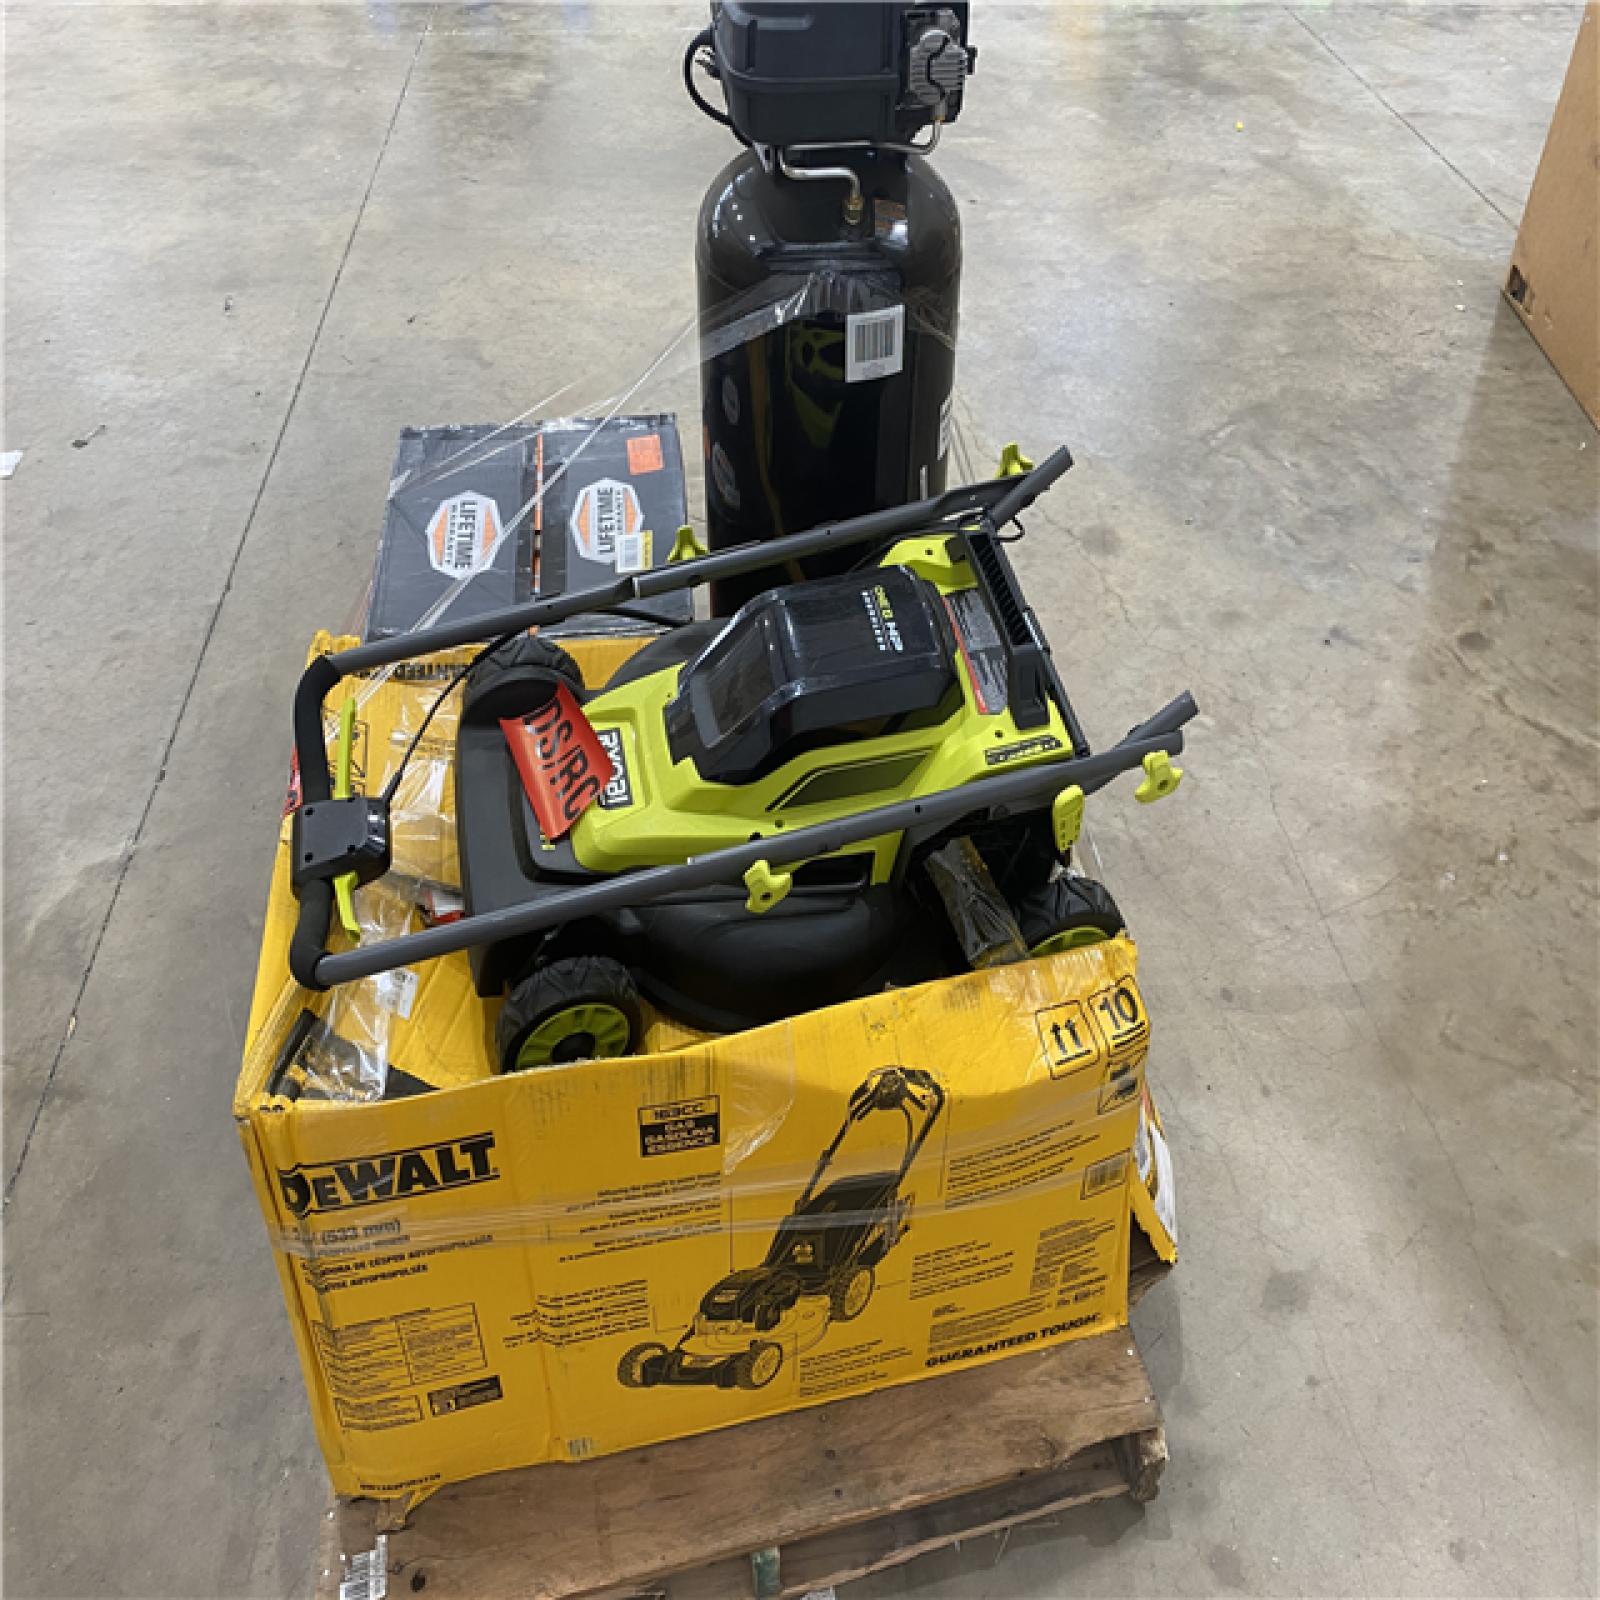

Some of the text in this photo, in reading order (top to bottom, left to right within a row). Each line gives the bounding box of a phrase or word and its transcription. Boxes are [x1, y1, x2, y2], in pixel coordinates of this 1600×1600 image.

[455, 500, 478, 569] LIFETIME
[597, 487, 616, 555] LIFETIME
[1099, 987, 1139, 1031] 10
[278, 1132, 498, 1218] DEWALT
